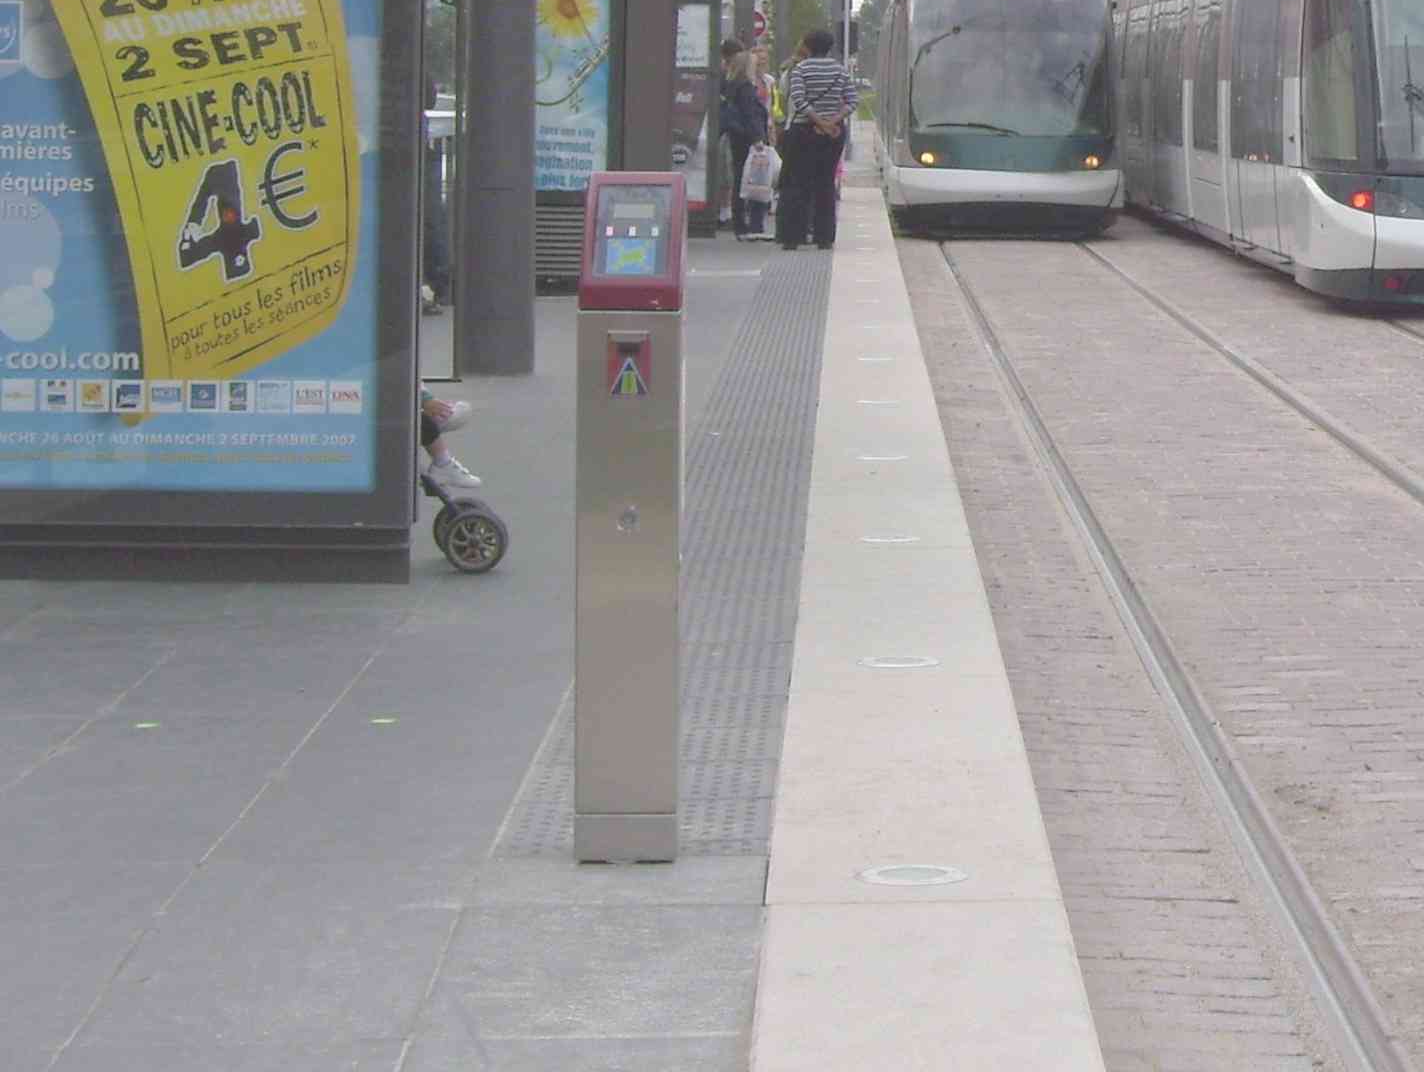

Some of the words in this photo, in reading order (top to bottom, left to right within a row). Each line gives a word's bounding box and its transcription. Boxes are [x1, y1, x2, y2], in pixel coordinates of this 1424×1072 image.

[104, 16, 144, 41] AU
[115, 45, 156, 82] 2
[1, 171, 94, 196] équipes
[170, 322, 207, 351] pour
[212, 301, 251, 330] tous
[256, 287, 283, 310] les
[290, 258, 343, 295] films
[195, 327, 240, 355] toutes
[242, 319, 264, 336] les
[135, 431, 216, 446] DIMANCHE
[231, 432, 320, 446] SEPTEMBRE
